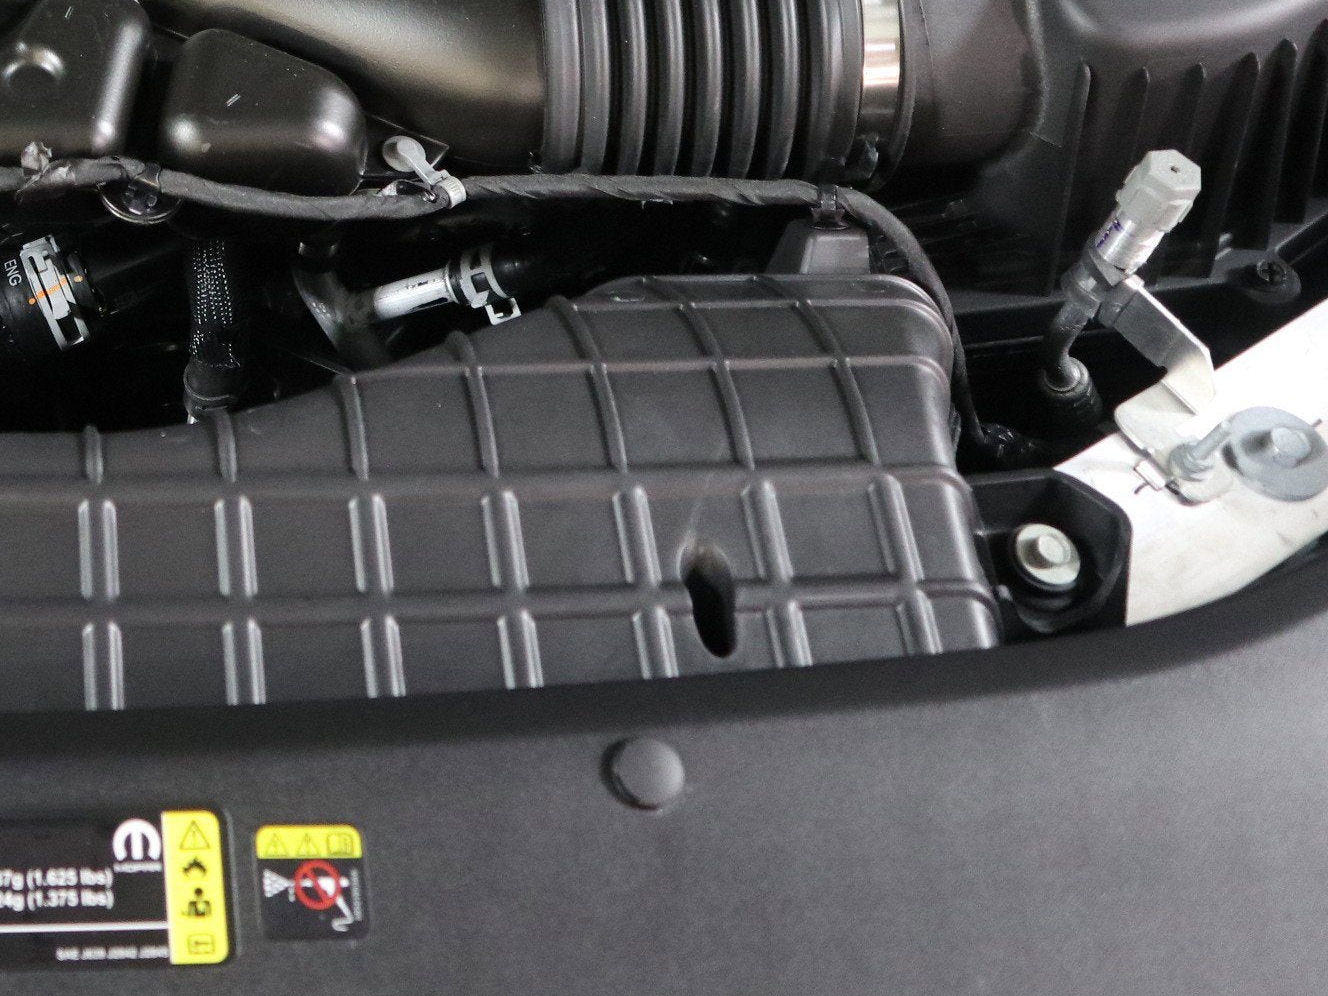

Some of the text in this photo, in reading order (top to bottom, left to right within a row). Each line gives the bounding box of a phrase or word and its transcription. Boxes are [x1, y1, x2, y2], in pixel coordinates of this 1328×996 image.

[3, 258, 22, 287] ENG
[26, 868, 78, 891] (1.625
[79, 867, 114, 889] lbs)
[27, 889, 79, 912] (1.375
[80, 888, 115, 910] lbs)
